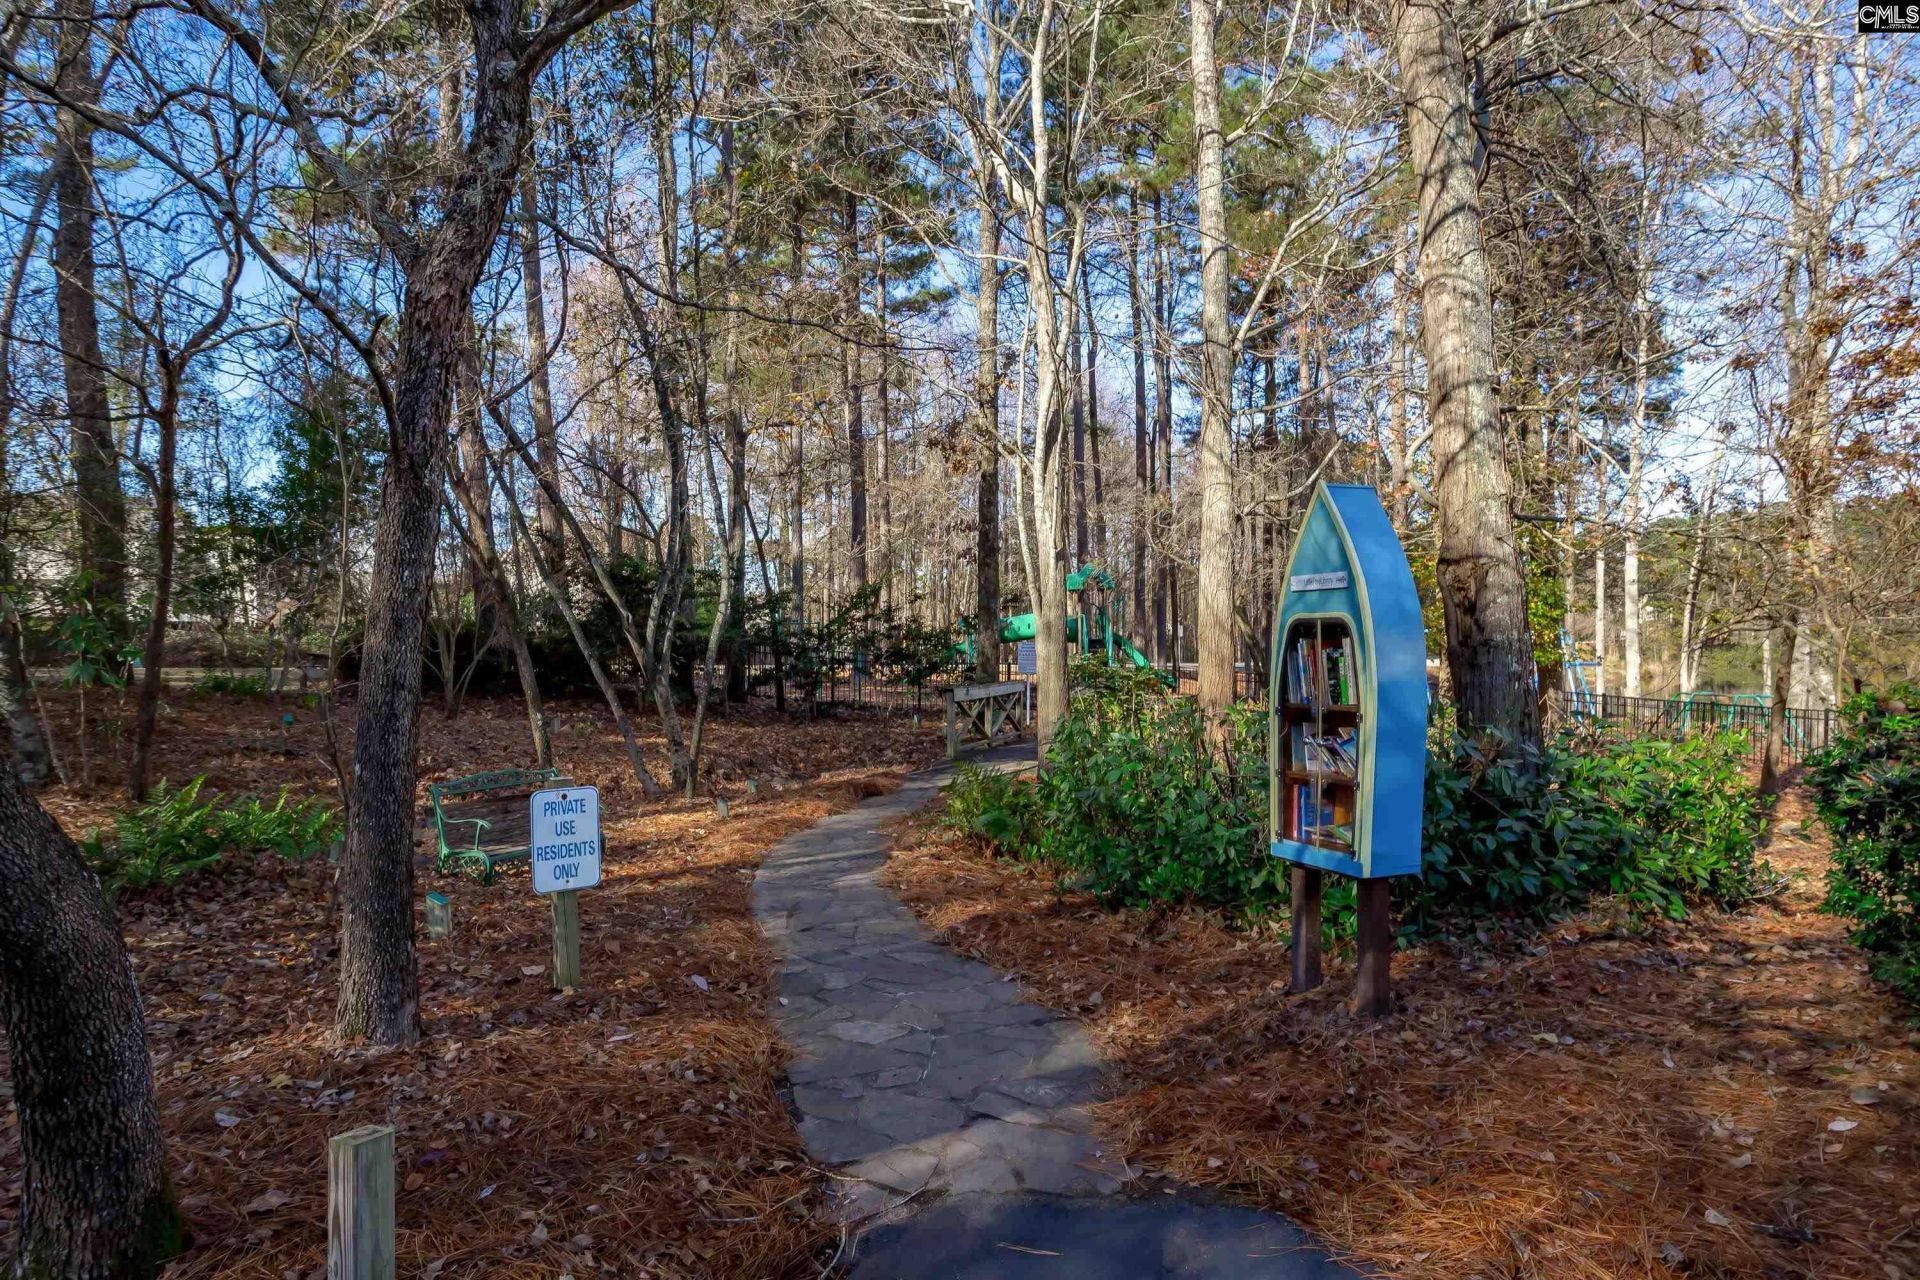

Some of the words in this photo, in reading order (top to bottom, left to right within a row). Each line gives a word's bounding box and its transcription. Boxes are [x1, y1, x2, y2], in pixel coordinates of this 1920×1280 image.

[544, 799, 586, 816] PRIVATE
[555, 820, 576, 836] USE
[537, 840, 595, 862] RESIDENTS
[553, 863, 580, 880] ONLY
